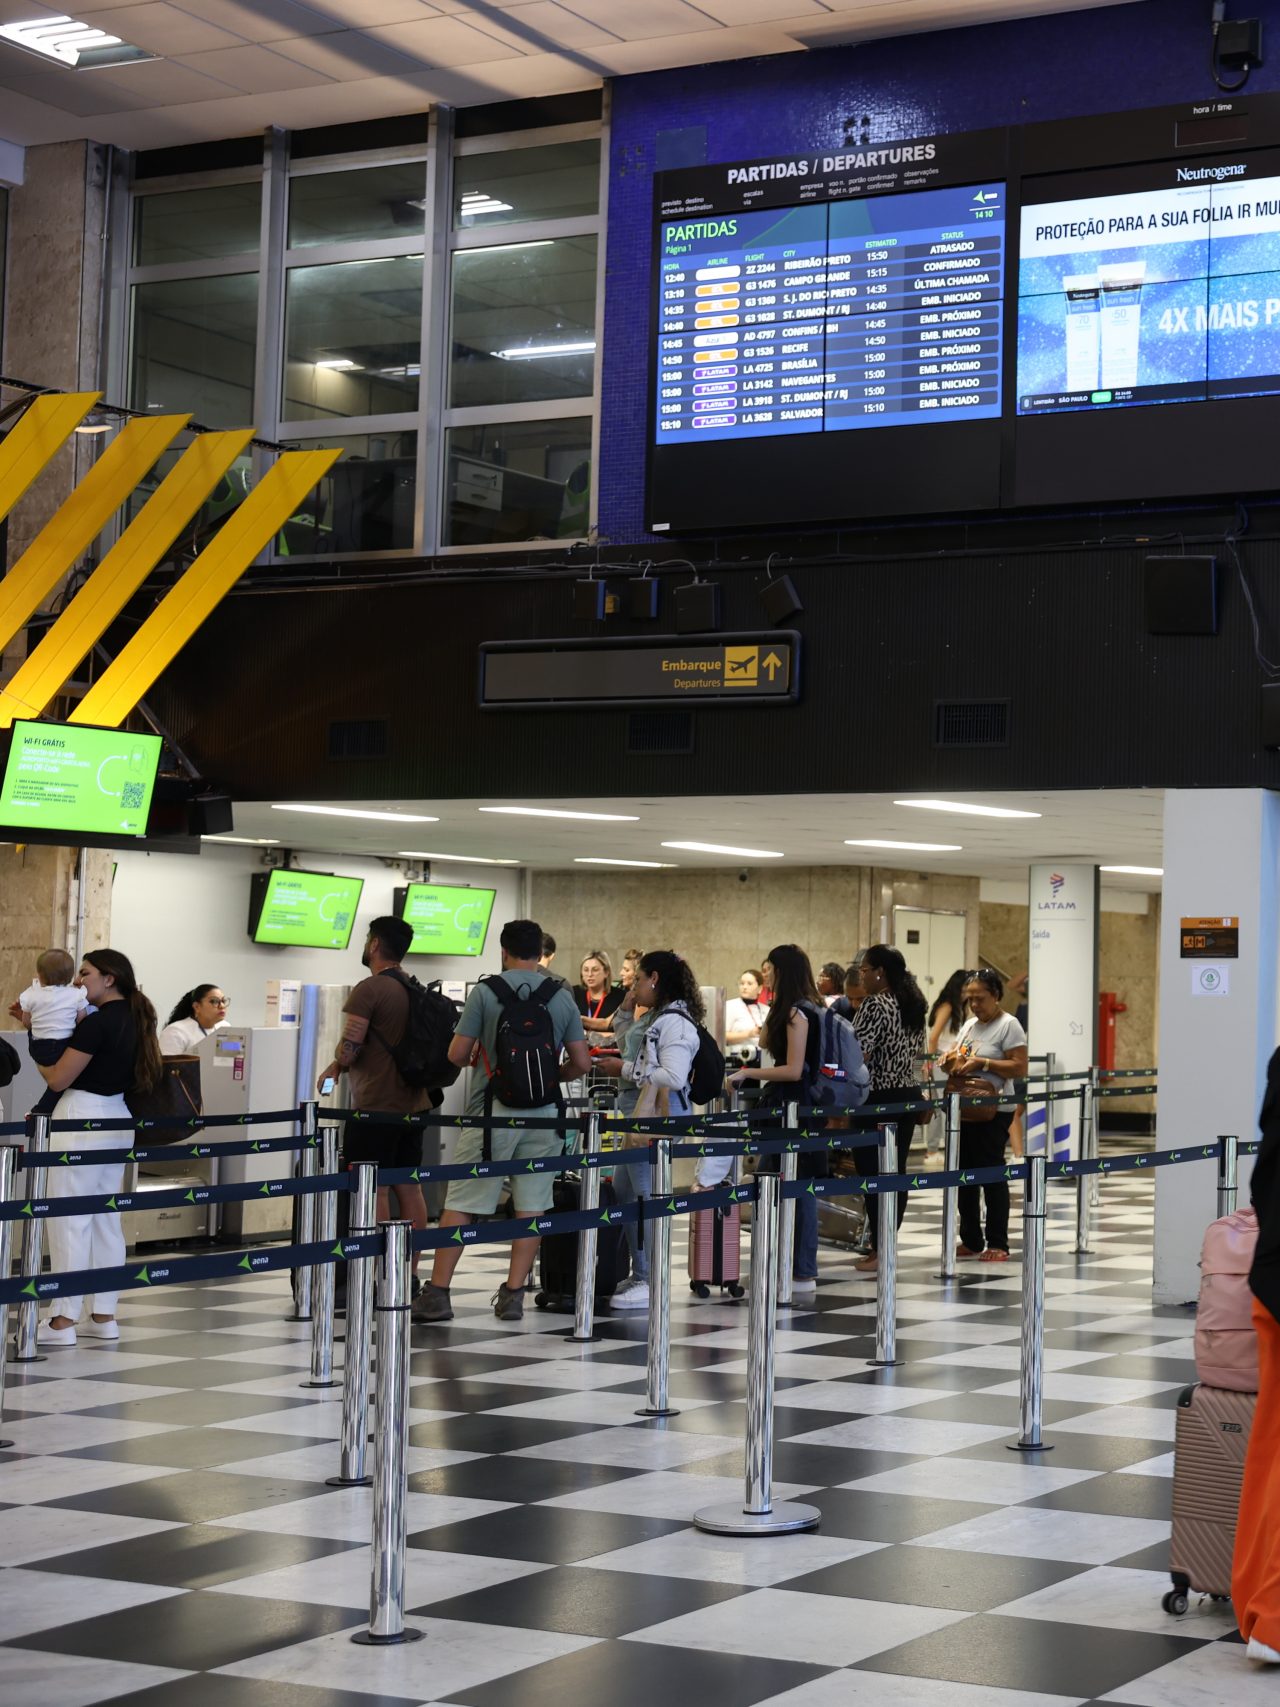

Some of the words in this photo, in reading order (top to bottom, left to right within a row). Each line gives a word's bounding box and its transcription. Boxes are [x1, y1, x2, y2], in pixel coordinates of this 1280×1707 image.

[1192, 104, 1209, 115] hora
[1217, 101, 1232, 112] time
[727, 159, 809, 185] PARTIDAS
[811, 158, 818, 174] /
[822, 143, 936, 173] DEPARTURES
[1176, 159, 1246, 185] Neutrogena
[665, 218, 737, 243] PARTIDAS
[1035, 216, 1105, 246] PROTEÇÃO
[1108, 214, 1144, 233] PARA
[1147, 213, 1158, 229] A
[1161, 209, 1189, 227] SUA
[1192, 204, 1234, 224] FOLIA
[1237, 202, 1252, 219] IR
[664, 243, 686, 256] Página
[687, 243, 692, 251] 1
[744, 252, 764, 262] FLIGHT
[782, 249, 796, 258] CITY
[864, 237, 897, 249] ESTIMATED
[940, 230, 964, 240] STATUS
[929, 240, 975, 254] ATRASADO
[783, 255, 822, 270] RIBEIRÃO
[822, 254, 851, 266] PRETO
[923, 256, 980, 272] CONFIRMADO
[783, 274, 813, 286] CAMPO
[814, 270, 851, 283] GRANDE
[913, 275, 946, 289] ÚLTIMA
[946, 272, 990, 286] CHAMADA
[920, 294, 942, 305] EMB.
[942, 290, 981, 303] INICIADO
[919, 313, 940, 324] EMB.
[941, 306, 981, 322] PRÓXIMO
[1158, 307, 1188, 335] 4X
[1195, 299, 1259, 331] MAIS
[920, 329, 941, 341] EMB.
[942, 326, 980, 338] INICIADO
[781, 342, 808, 354] RECIFE
[919, 347, 940, 358] EMB.
[941, 341, 981, 356] PRÓXIMO
[781, 356, 818, 370] BRASÍLIA
[918, 364, 939, 375] EMB.
[940, 358, 981, 373] PRÓXIMO
[780, 373, 836, 387] NAVEGANTES
[919, 380, 940, 391] EMB.
[941, 377, 979, 390] INICIADO
[919, 398, 940, 409] EMB.
[941, 394, 979, 407] INICIADO
[1058, 395, 1070, 404] SÃO
[1070, 394, 1088, 403] PAULO
[780, 407, 823, 420] SALVADOR
[661, 658, 722, 673] Embarque
[673, 677, 721, 690] Departures
[42, 738, 66, 748] GRÁTIS
[1038, 902, 1077, 910] LATAM
[135, 1151, 148, 1159] aena
[269, 1183, 283, 1192] aena
[737, 1189, 749, 1199] aena
[195, 1191, 209, 1199] aena
[33, 1203, 49, 1212] aena
[609, 1210, 622, 1219] aena
[462, 1229, 477, 1239] aena
[344, 1242, 360, 1253] aena
[251, 1256, 269, 1265] aena
[151, 1268, 170, 1278] aena
[38, 1281, 59, 1292] aena
